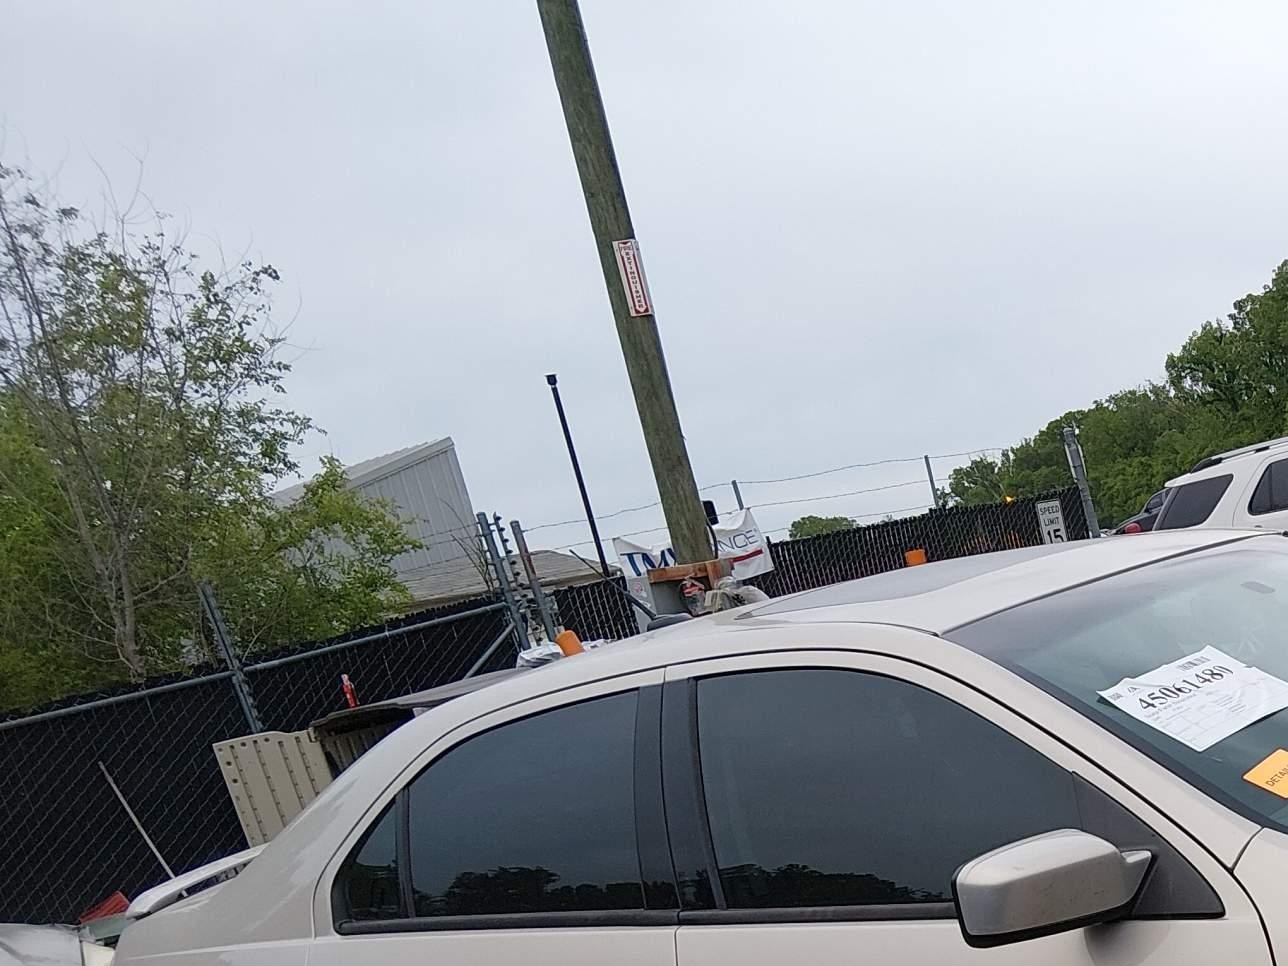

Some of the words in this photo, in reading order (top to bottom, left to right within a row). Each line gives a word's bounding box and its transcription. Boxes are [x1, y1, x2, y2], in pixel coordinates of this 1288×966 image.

[1040, 505, 1060, 515] SPEED
[1043, 516, 1060, 527] LIMIT
[1047, 528, 1064, 544] 15
[1138, 665, 1234, 710] 45061480
